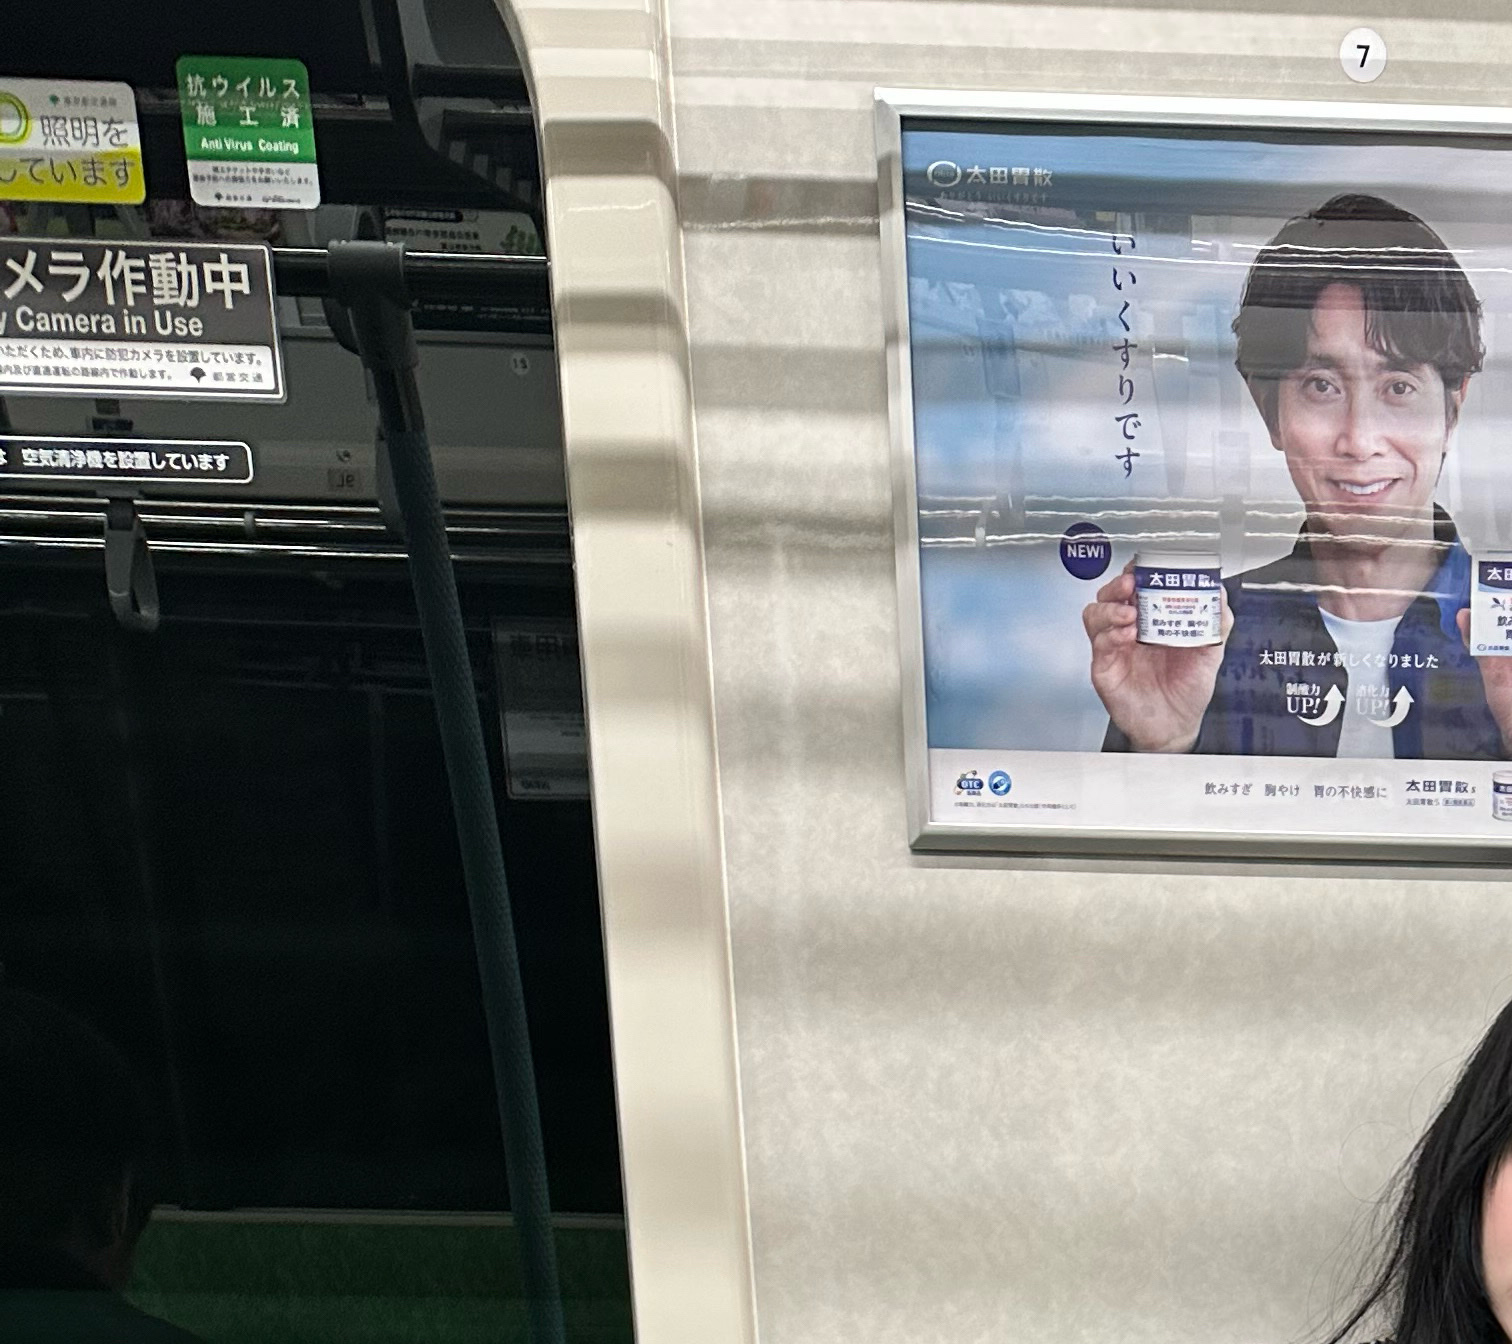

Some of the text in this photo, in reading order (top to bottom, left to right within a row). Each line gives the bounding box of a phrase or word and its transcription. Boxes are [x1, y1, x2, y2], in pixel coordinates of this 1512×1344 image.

[1356, 44, 1370, 68] 7
[186, 73, 300, 98] 抗ウイルス
[40, 115, 129, 147] 照明を
[201, 136, 299, 154] Anti Virus Coating
[966, 165, 1053, 187] 太田胃散
[4, 249, 251, 310] メラ作動中
[15, 305, 116, 334] Camera
[123, 308, 147, 335] in
[154, 309, 204, 337] Use
[1113, 234, 1142, 478] いいくすりです
[21, 448, 230, 471] 空気清浄機を設置しています
[1067, 544, 1105, 559] NEW!
[1259, 650, 1439, 669] 太田胃散が新しくなりました
[1286, 697, 1321, 714] UP!
[1356, 697, 1390, 716] UP!
[1204, 781, 1388, 799] 飲みすぎ 胸やけ 胃の不快感に
